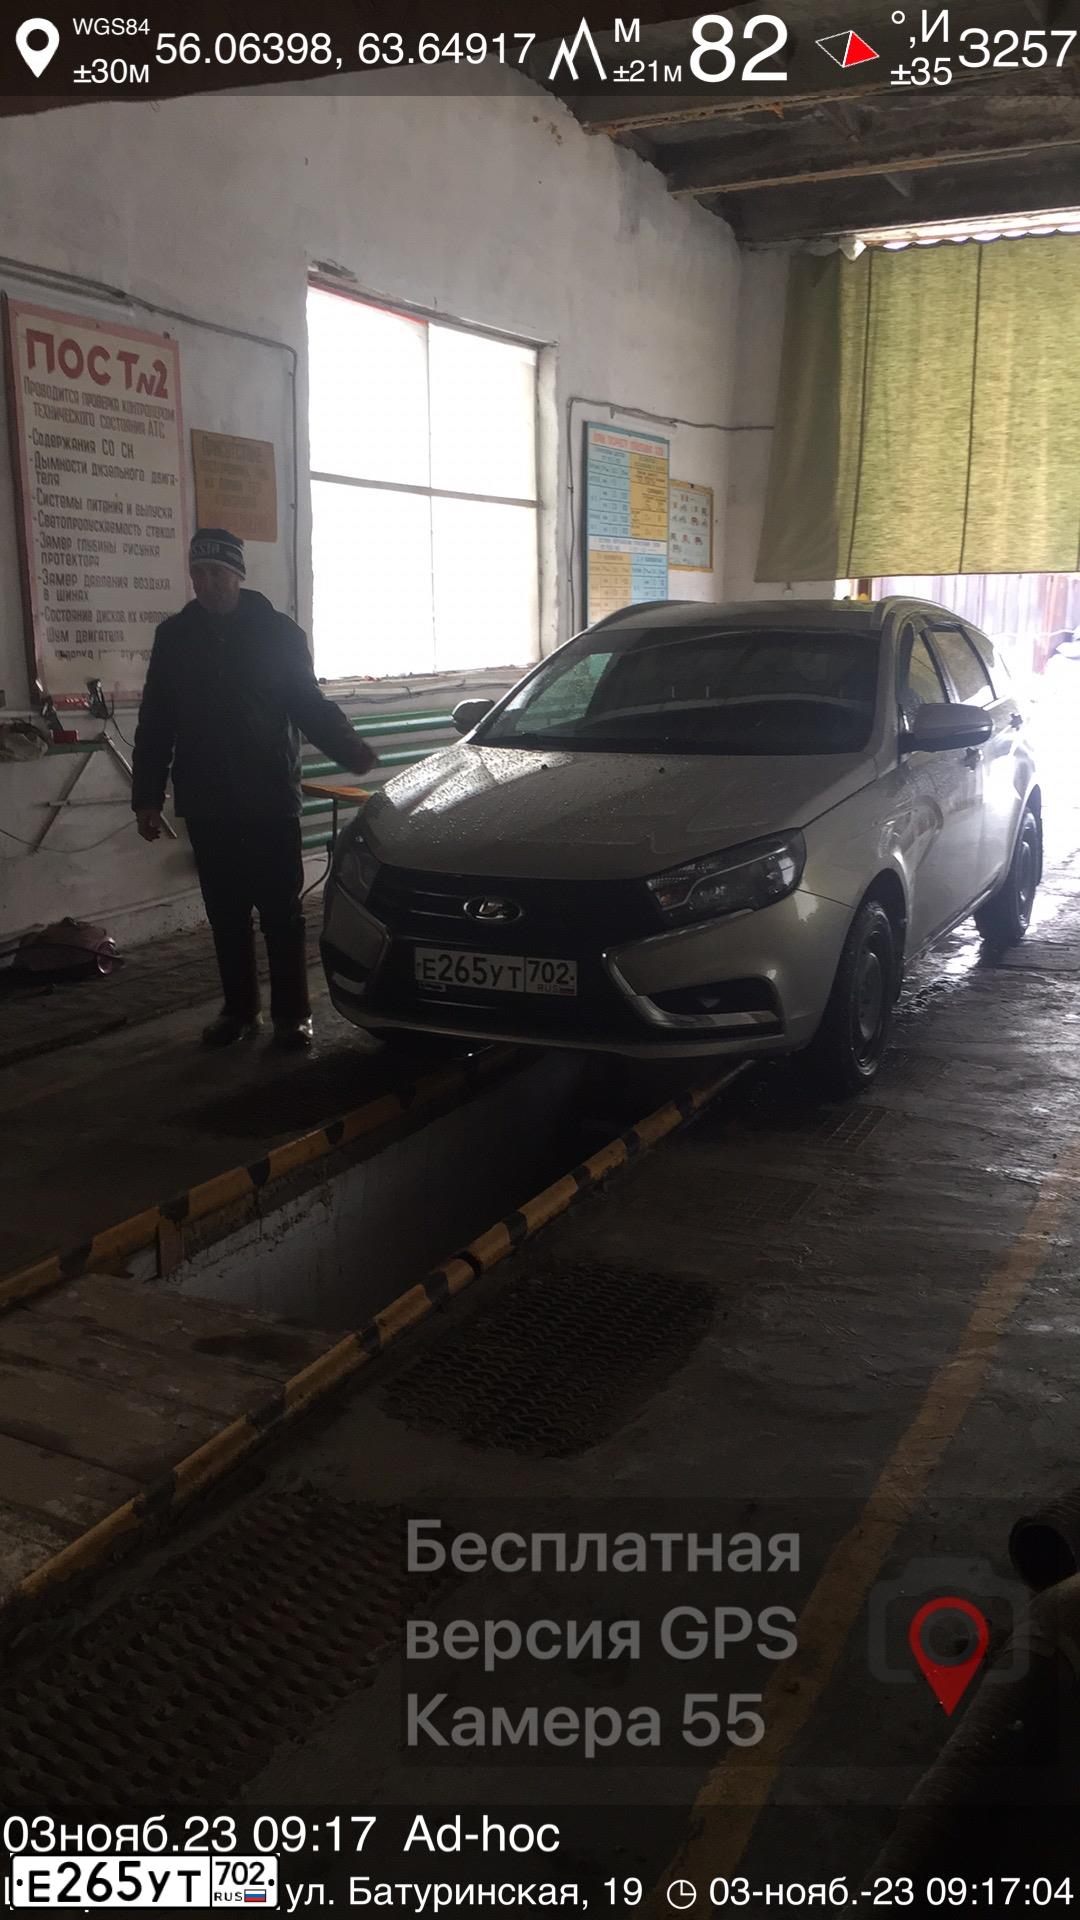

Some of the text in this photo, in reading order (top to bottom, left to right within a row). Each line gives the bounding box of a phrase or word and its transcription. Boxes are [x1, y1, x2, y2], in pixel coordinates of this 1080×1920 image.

[26, 328, 140, 390] ПОСТ
[148, 418, 166, 439] АТС
[101, 438, 115, 456] СО
[126, 503, 133, 516] и
[41, 551, 99, 567] протектора
[43, 589, 89, 602] в шинах
[422, 954, 570, 989] Е265УТ 702
